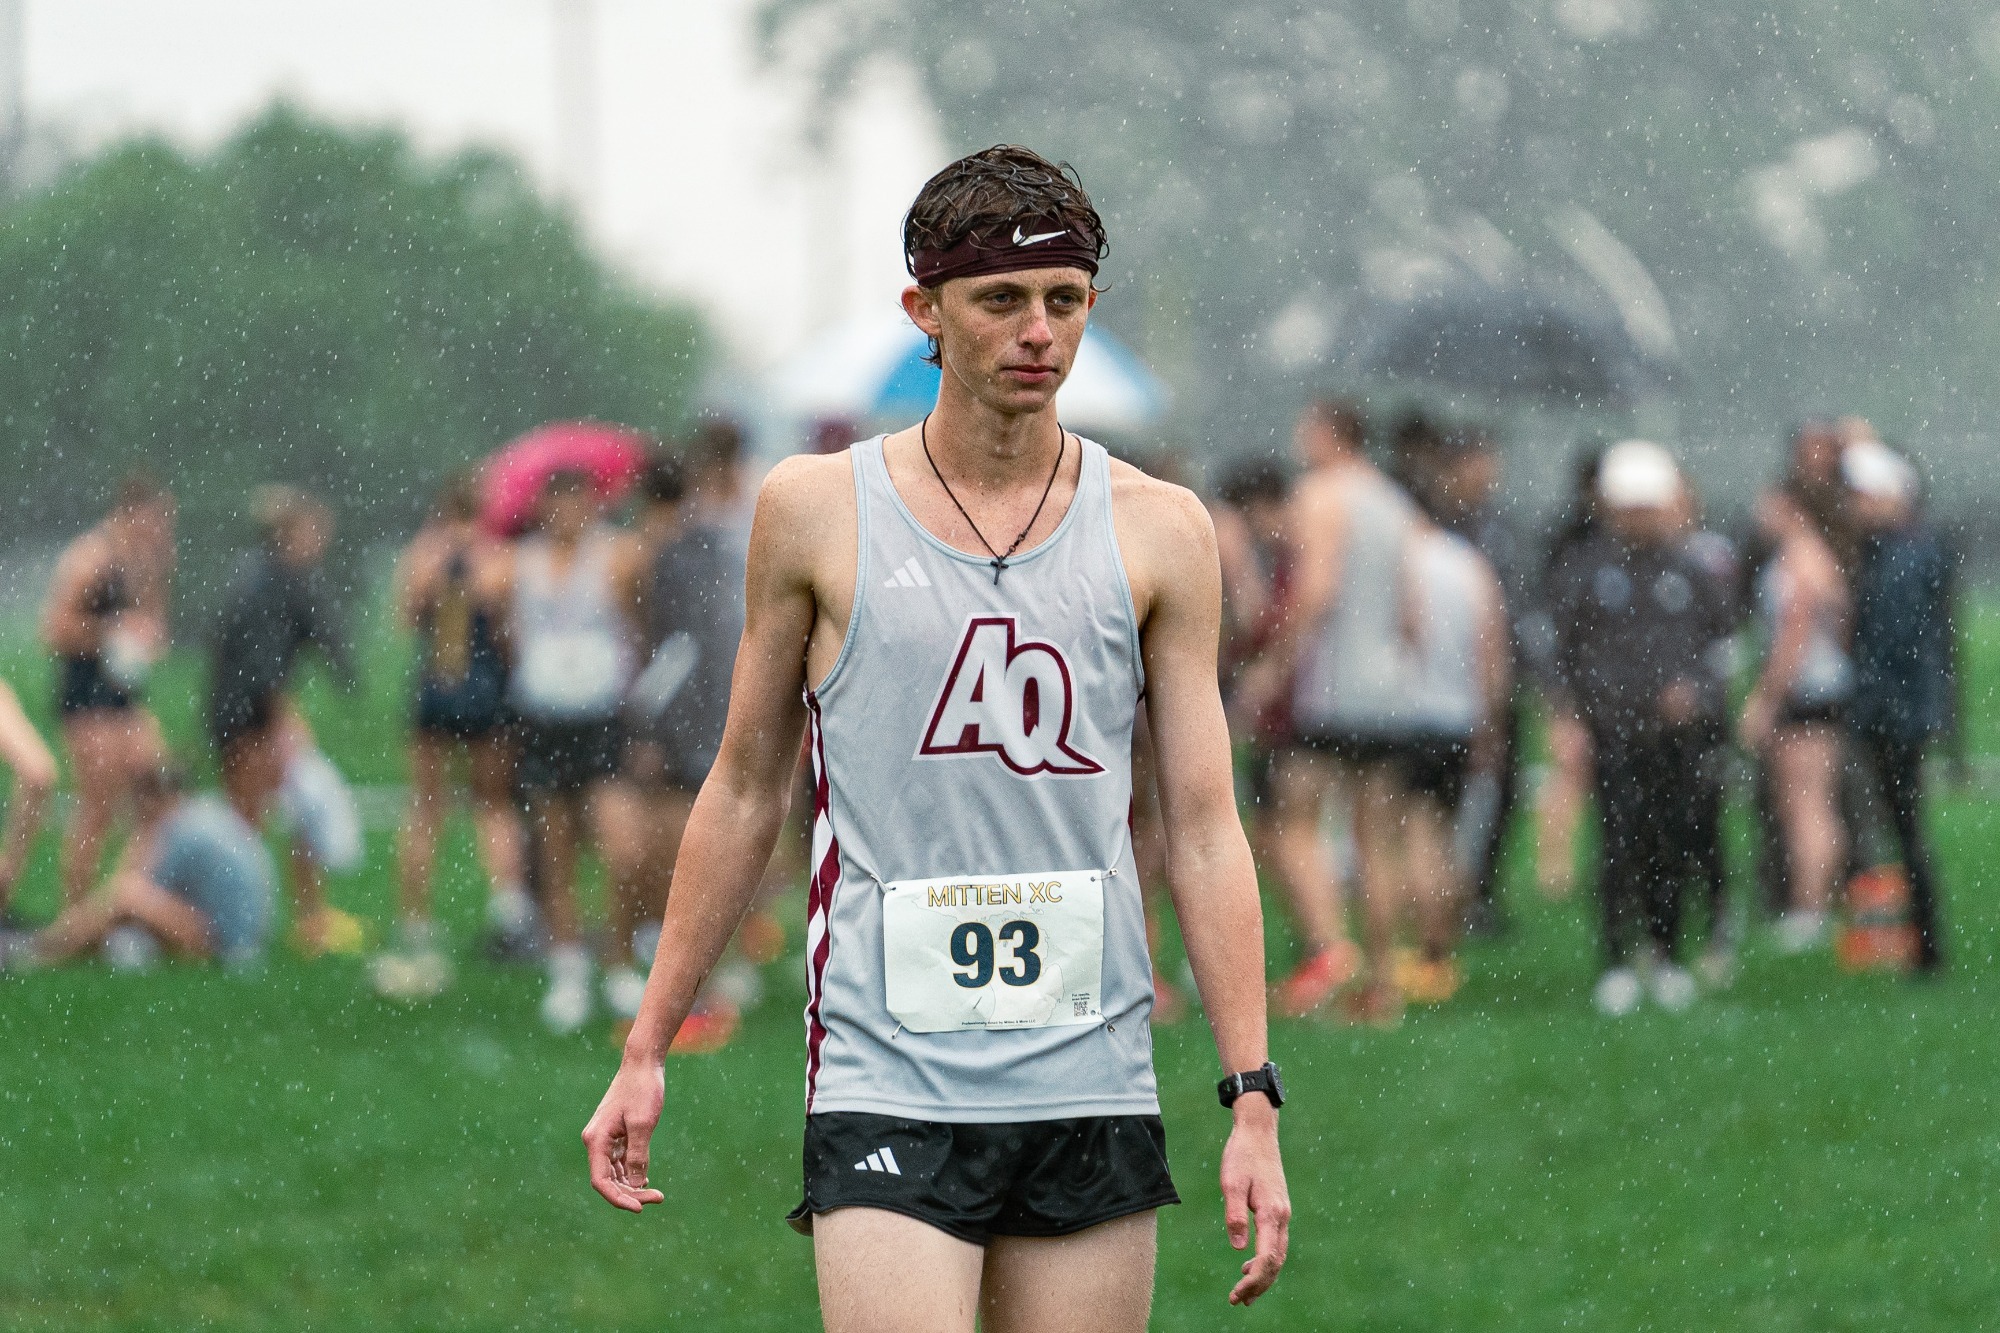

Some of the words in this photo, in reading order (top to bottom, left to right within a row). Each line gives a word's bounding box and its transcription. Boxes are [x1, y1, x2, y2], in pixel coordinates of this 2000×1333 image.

[917, 615, 1107, 776] AQ
[928, 883, 1021, 907] MITTEN
[1029, 881, 1062, 903] XC
[950, 920, 1042, 989] 93
